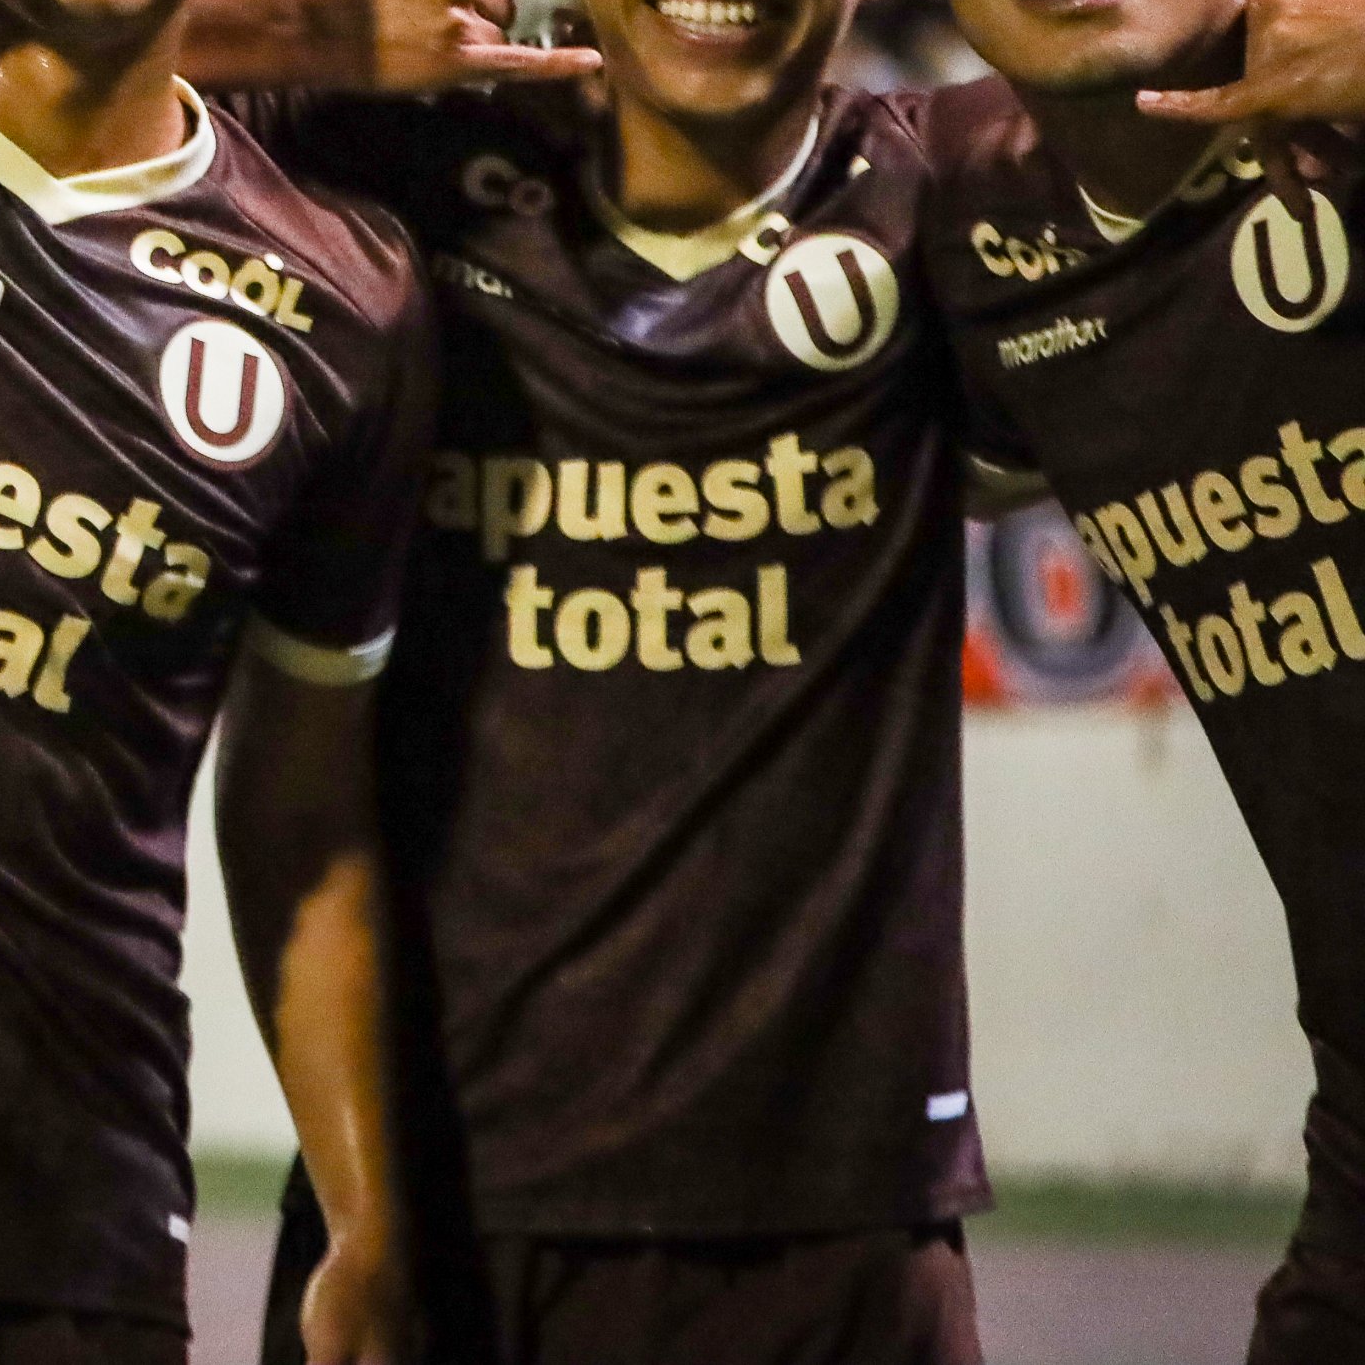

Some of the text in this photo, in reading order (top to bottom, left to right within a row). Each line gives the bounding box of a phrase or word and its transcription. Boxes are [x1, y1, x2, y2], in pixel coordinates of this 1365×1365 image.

[784, 248, 876, 359] U
[1252, 216, 1327, 319] U
[185, 339, 259, 448] U
[427, 433, 881, 560] apuesta
[507, 563, 801, 672] total
[1159, 556, 1365, 703] total
